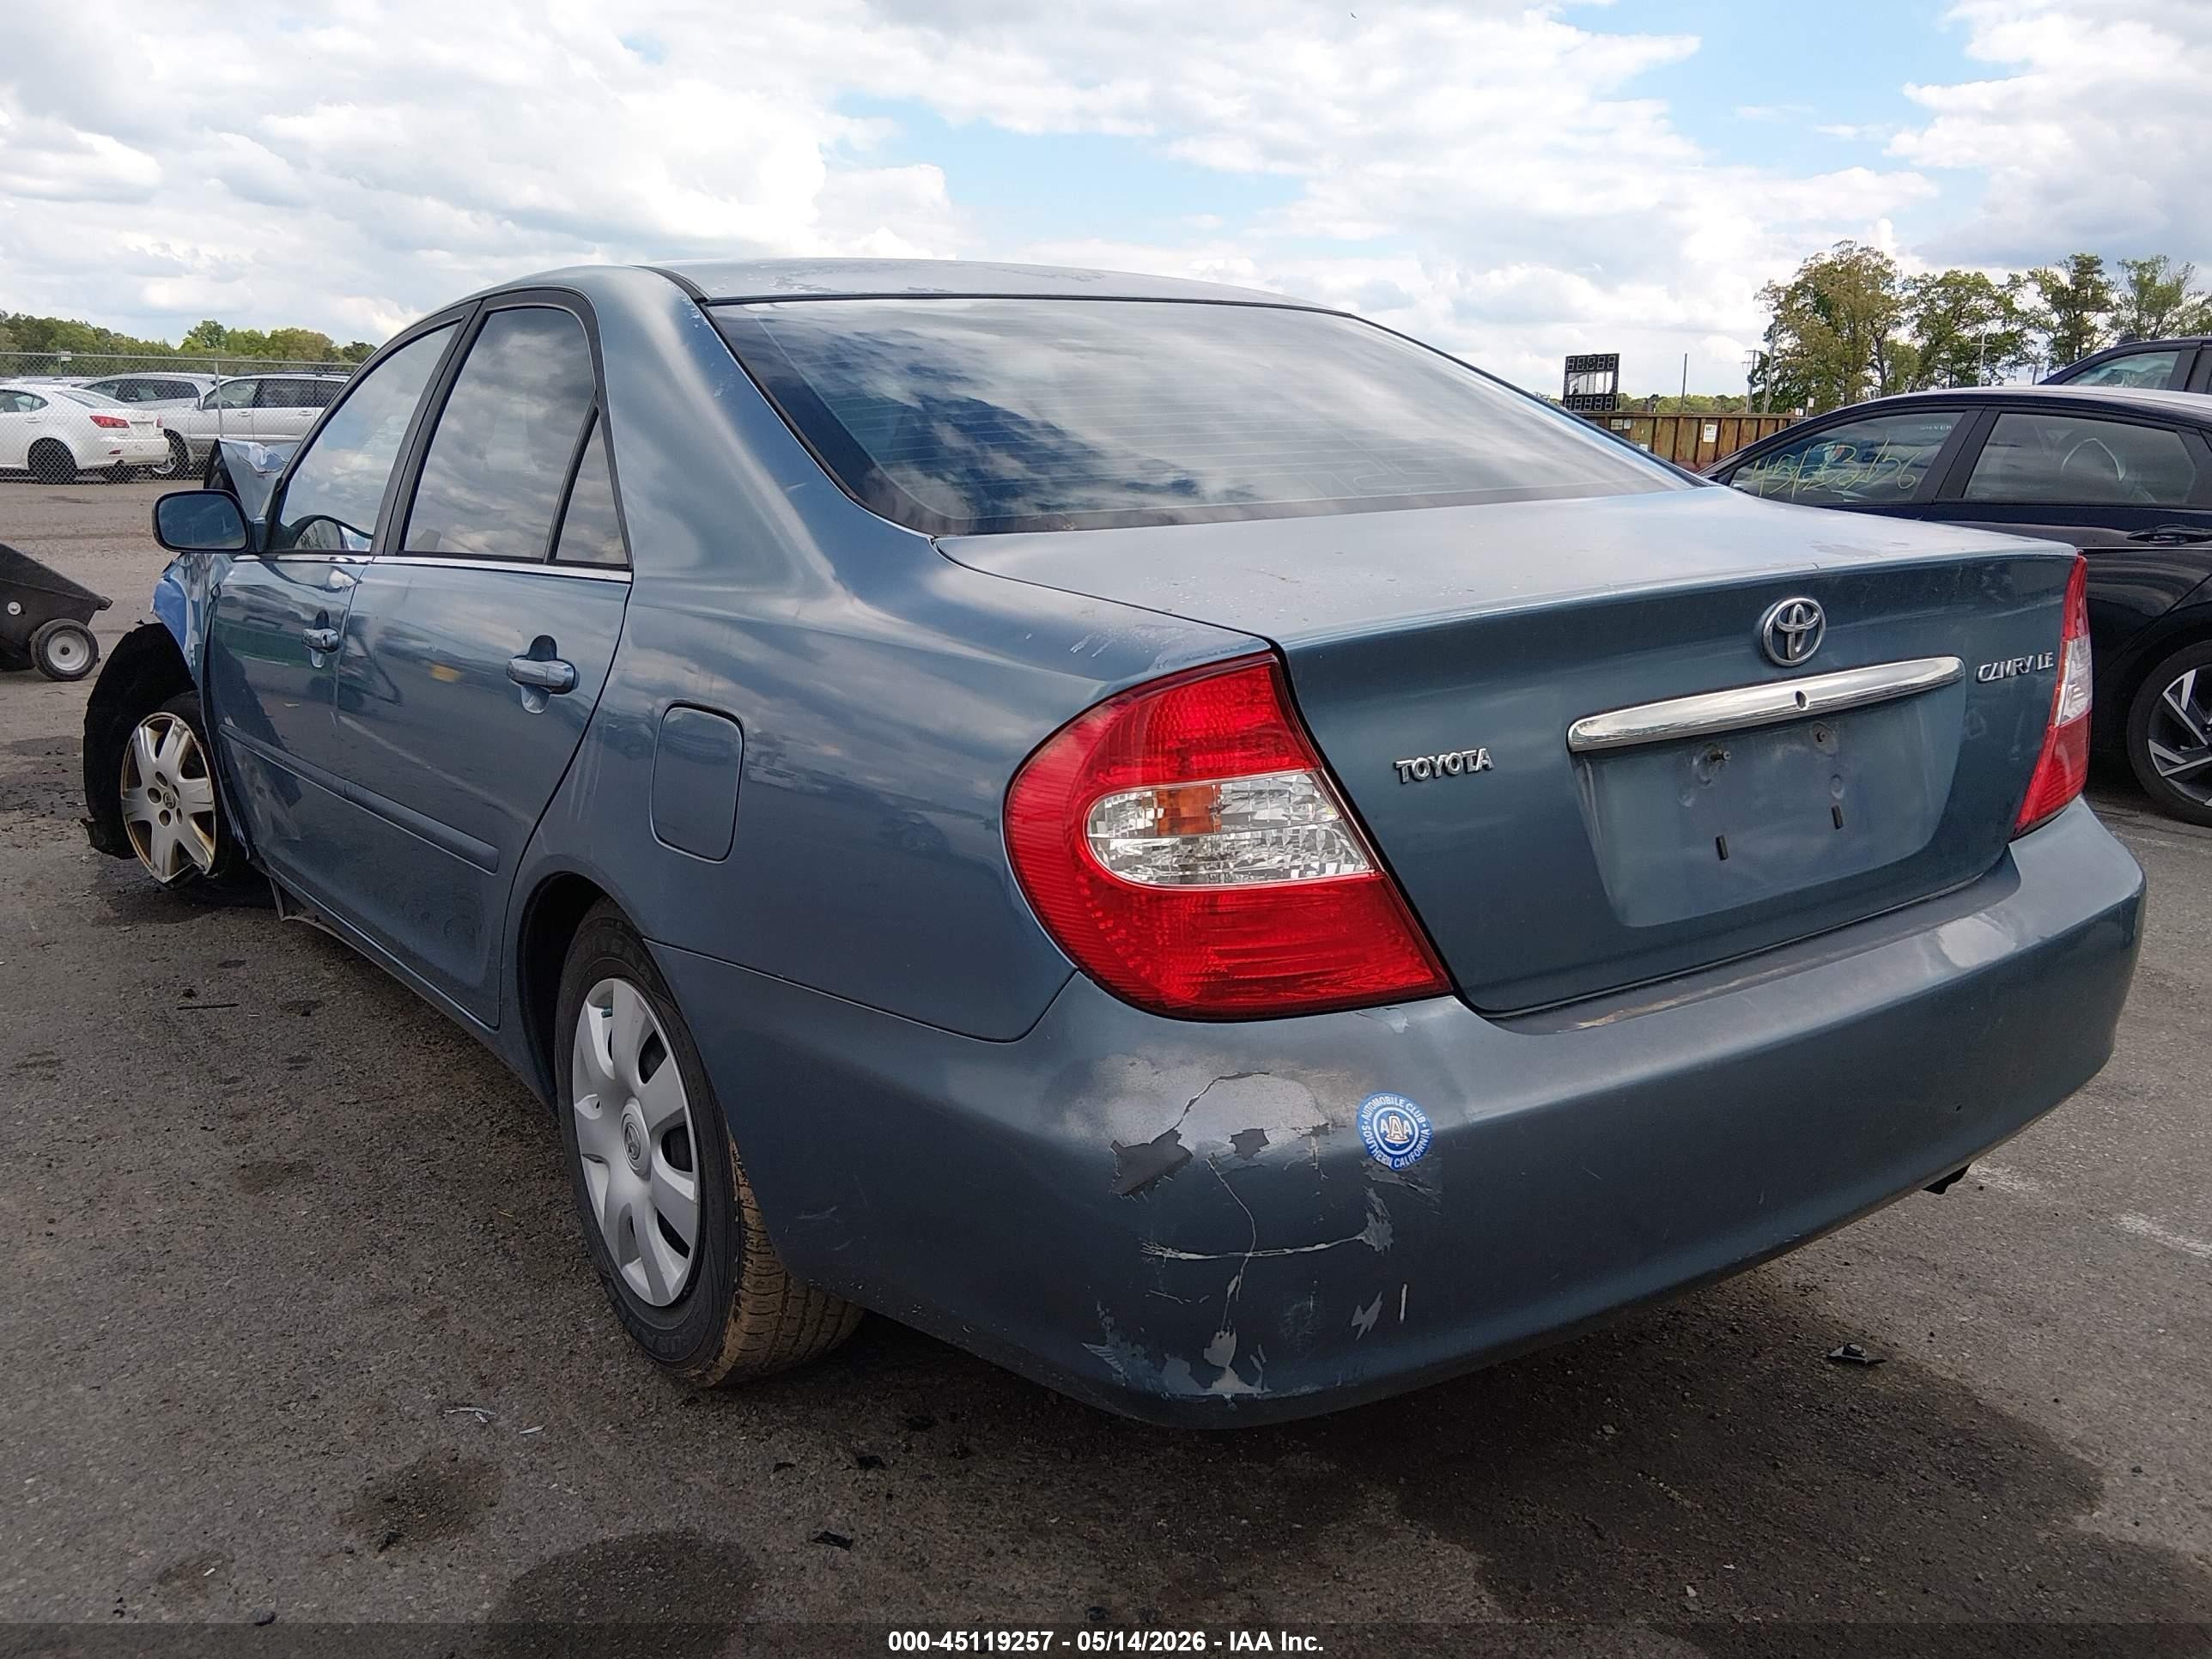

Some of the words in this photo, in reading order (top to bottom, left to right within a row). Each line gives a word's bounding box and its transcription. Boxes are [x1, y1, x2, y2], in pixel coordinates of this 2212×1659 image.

[1977, 656, 2033, 682] CAMRY
[2037, 652, 2054, 671] LE
[1395, 748, 1495, 783] TOYOTA
[1360, 1096, 1405, 1121] AUTOMOBILE
[1405, 1103, 1425, 1123] CLUB
[1380, 1115, 1413, 1138] AAA
[1361, 1125, 1392, 1166] SOUTHERN
[1394, 1129, 1431, 1168] CALIFORNIA
